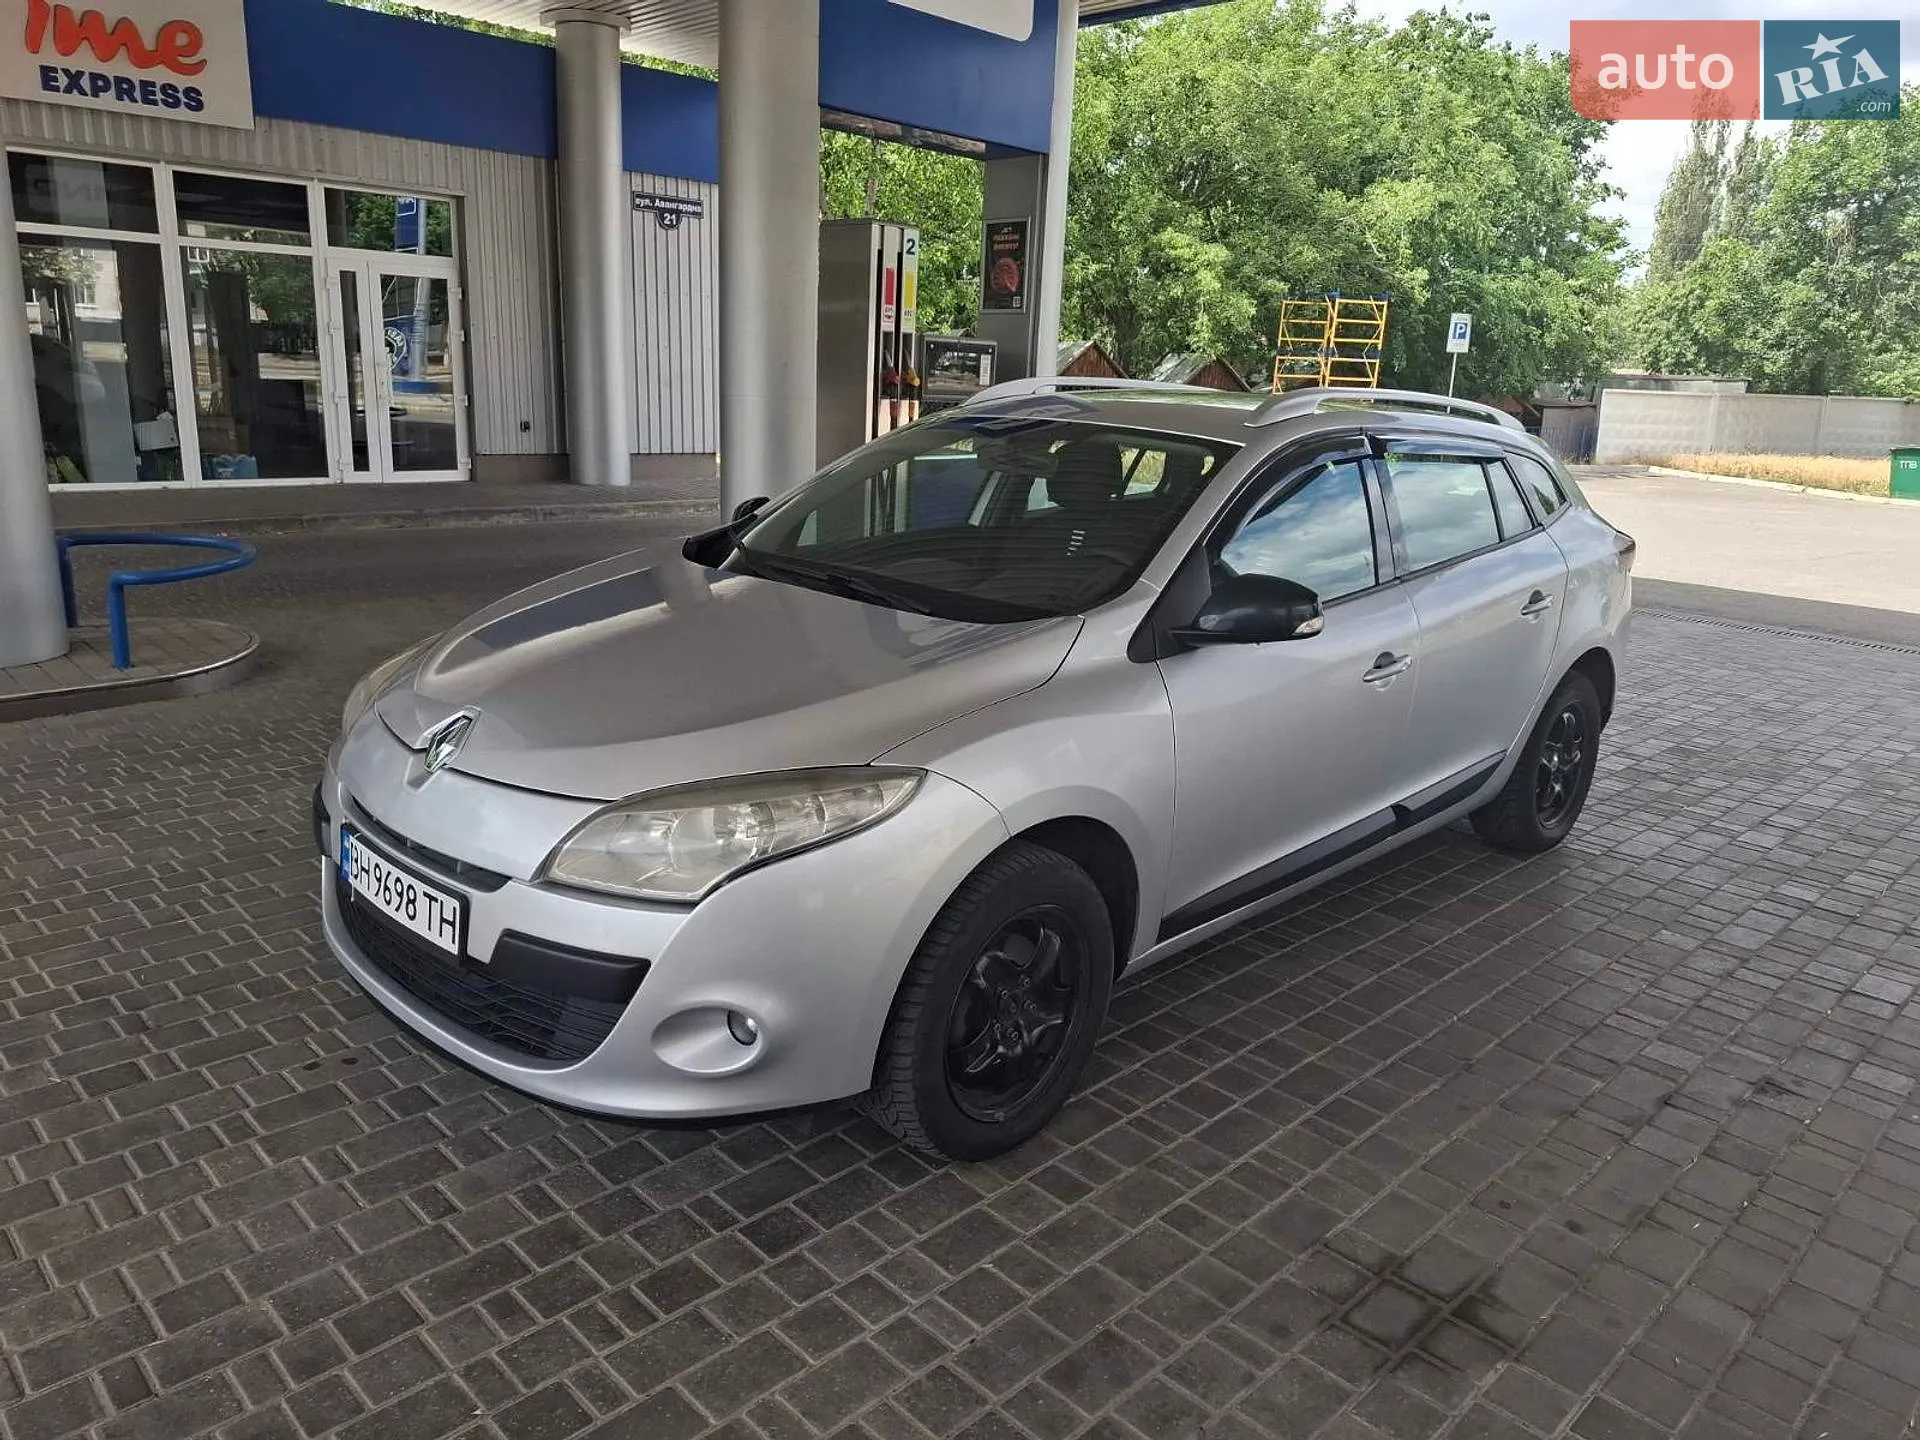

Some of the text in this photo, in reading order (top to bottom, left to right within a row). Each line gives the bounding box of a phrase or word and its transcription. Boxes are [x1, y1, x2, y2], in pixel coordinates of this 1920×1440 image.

[39, 64, 205, 112] EXPRESS
[663, 213, 677, 226] 21
[905, 238, 916, 256] 2
[1455, 323, 1467, 339] P
[373, 862, 417, 922] 9698
[422, 890, 457, 945] TH
